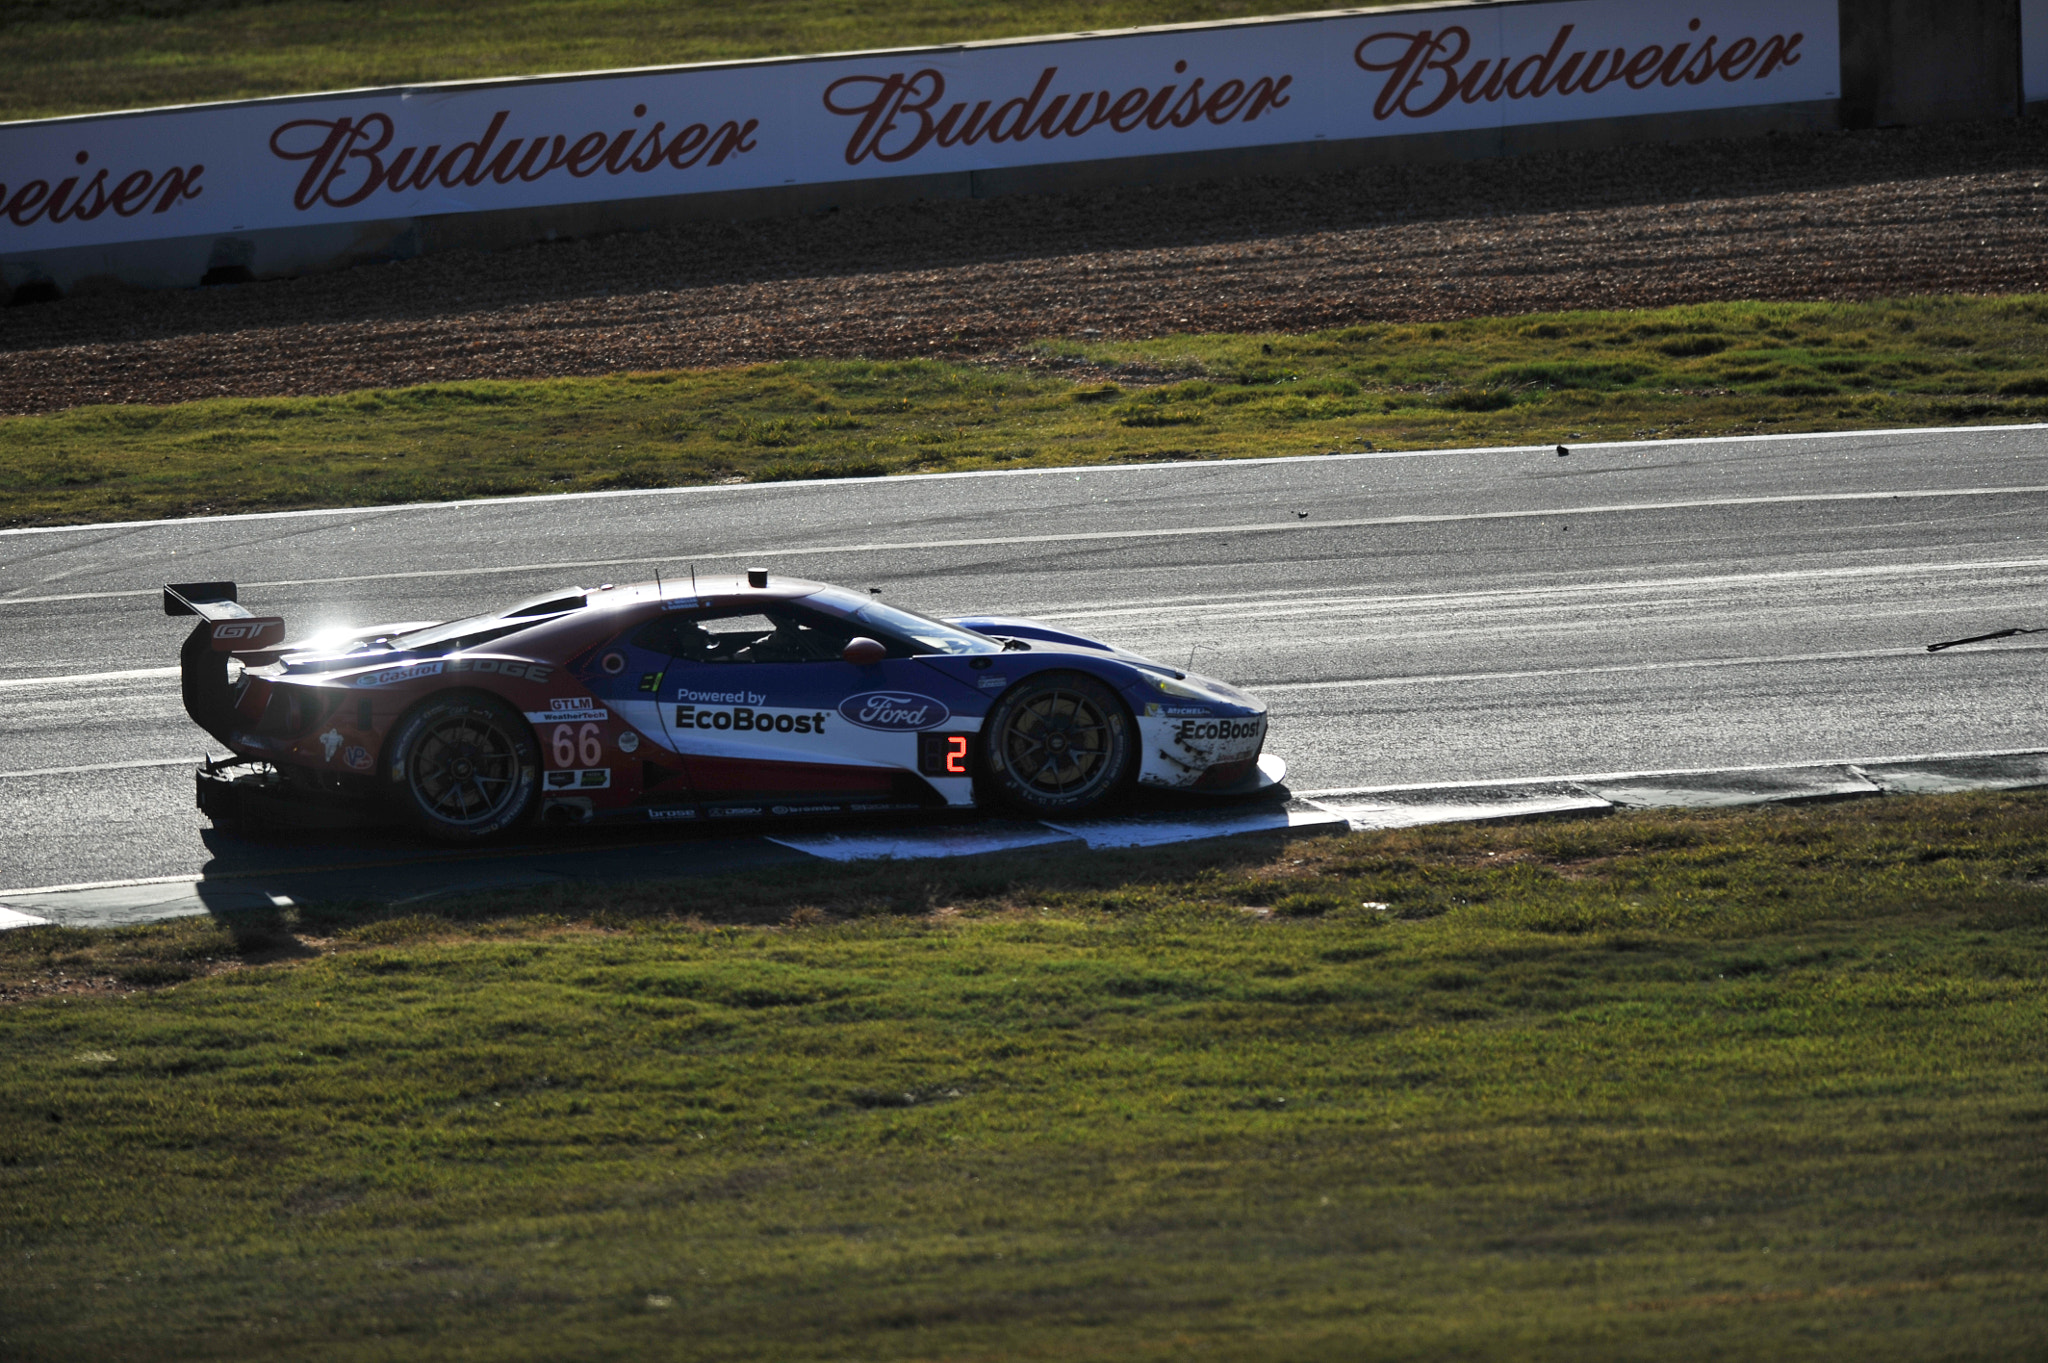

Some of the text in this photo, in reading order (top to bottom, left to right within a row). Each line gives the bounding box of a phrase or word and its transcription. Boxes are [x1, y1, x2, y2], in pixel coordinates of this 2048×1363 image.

[1354, 18, 1803, 121] Budweiser
[823, 60, 1292, 165] Budweiser
[269, 103, 758, 210] Budweiser
[213, 621, 283, 639] GT
[379, 660, 554, 683] Castrol EDGE
[552, 699, 591, 710] GTLM
[678, 689, 766, 706] Powered by
[859, 695, 928, 724] Ford
[544, 712, 605, 721] WeatherTech
[676, 705, 826, 734] EcoBoost
[1182, 720, 1260, 740] EcoBoost
[552, 722, 602, 768] 66
[946, 736, 967, 774] 2
[648, 808, 695, 818] brose
